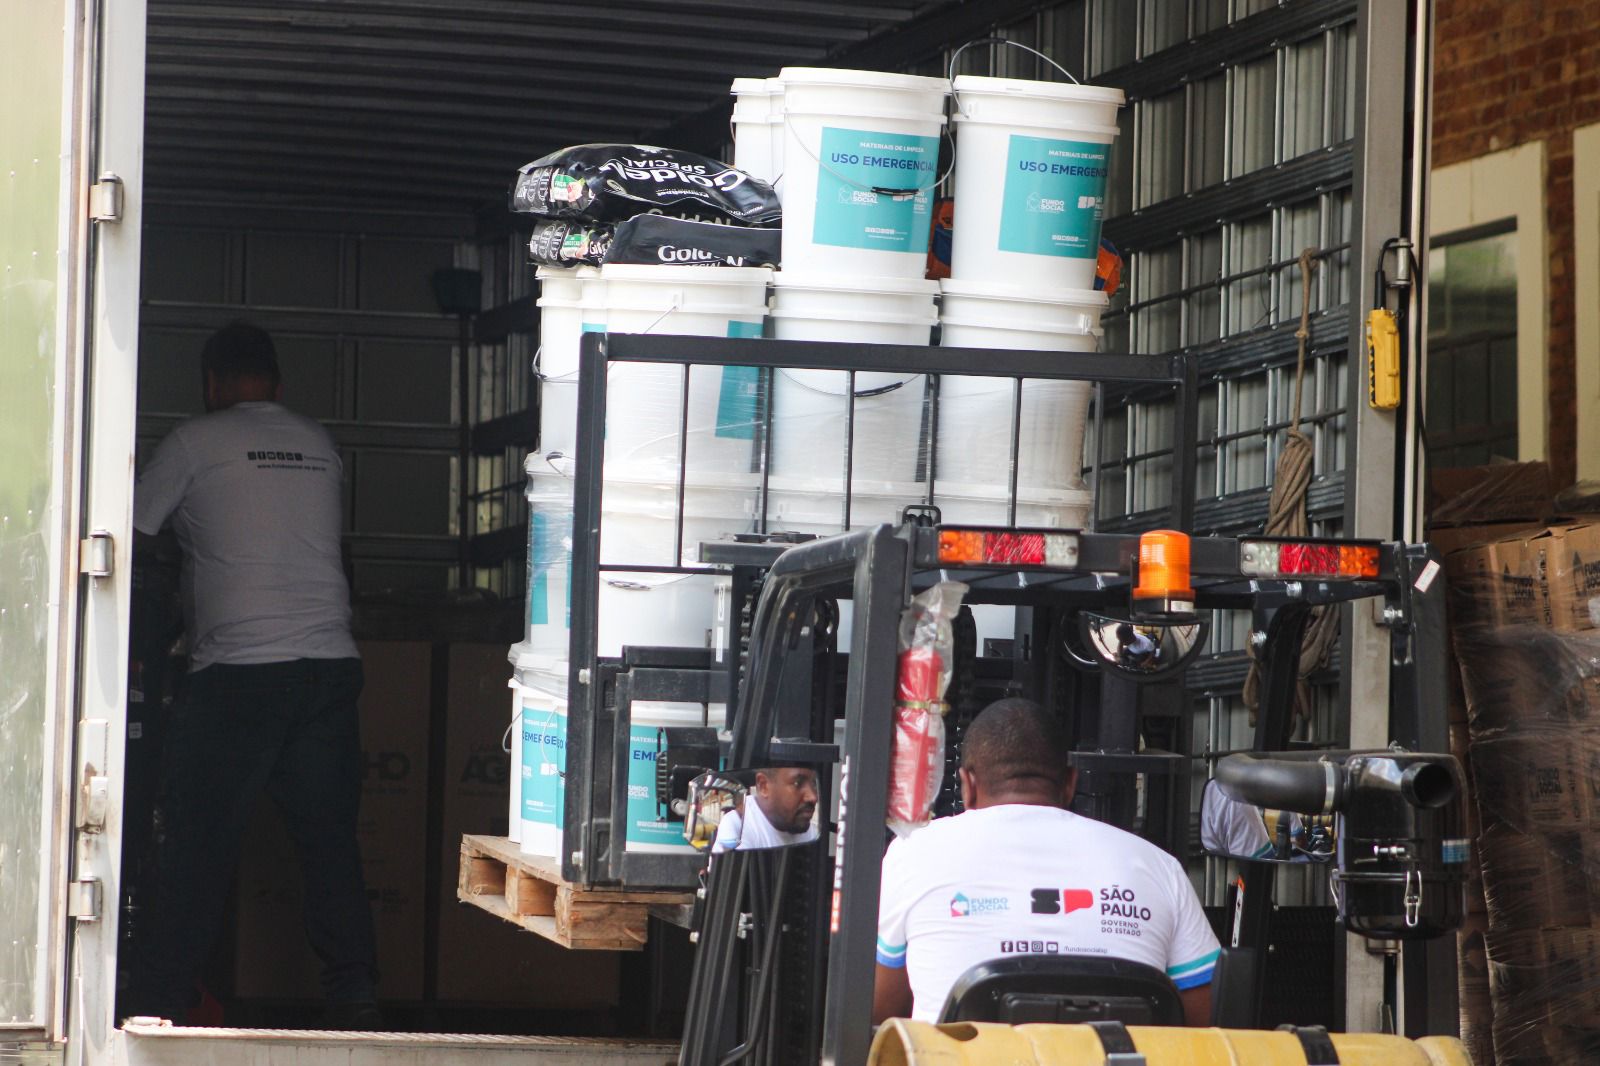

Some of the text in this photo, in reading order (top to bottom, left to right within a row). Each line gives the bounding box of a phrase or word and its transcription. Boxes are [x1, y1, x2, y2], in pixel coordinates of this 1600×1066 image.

[622, 156, 706, 175] SPECIAL
[831, 153, 935, 172] USO EMERGENCIAL
[1019, 160, 1048, 173] USO
[1100, 885, 1135, 902] SÃO
[971, 897, 1008, 905] FUNDO
[971, 904, 1010, 912] SOCIAL
[1101, 903, 1151, 921] PAULO
[1101, 919, 1139, 929] GOVERNO
[1115, 927, 1142, 937] ESTADO
